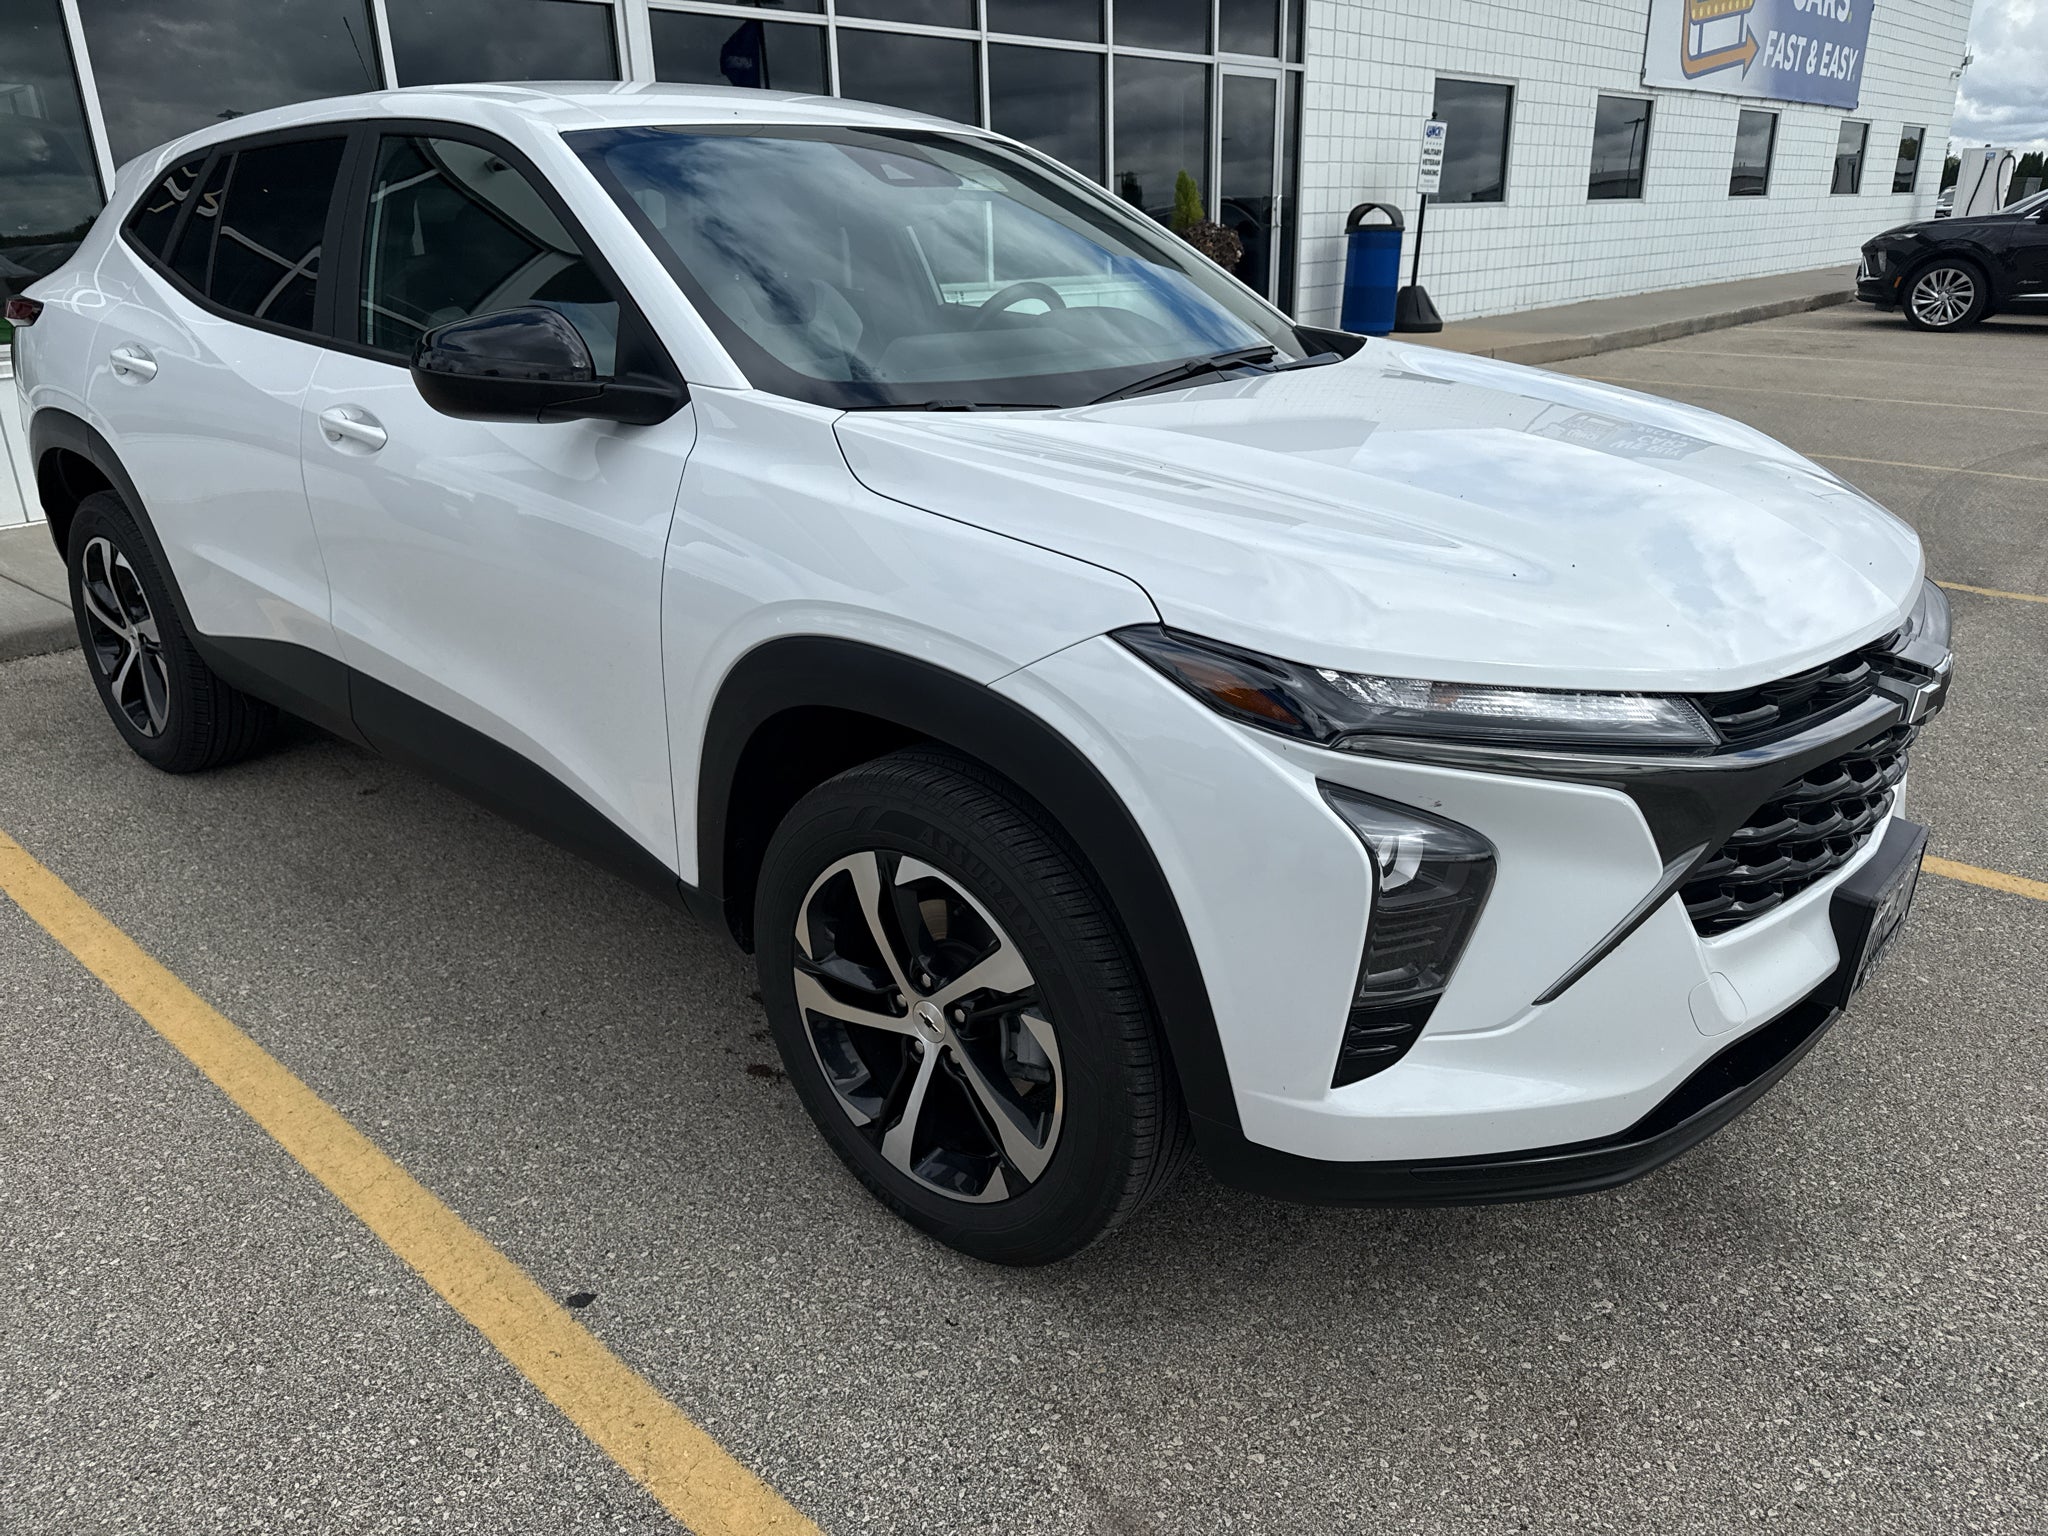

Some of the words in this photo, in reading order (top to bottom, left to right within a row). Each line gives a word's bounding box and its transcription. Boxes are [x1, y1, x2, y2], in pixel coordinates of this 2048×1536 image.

[1793, 0, 1850, 23] ARS
[1762, 30, 1807, 72] FAST
[1806, 39, 1818, 75] &
[1819, 42, 1859, 81] EASY
[1424, 148, 1442, 156] MILITARY
[1423, 158, 1441, 166] VETERAN
[1421, 169, 1439, 177] PARKING
[918, 825, 1063, 976] ASSURANCE
